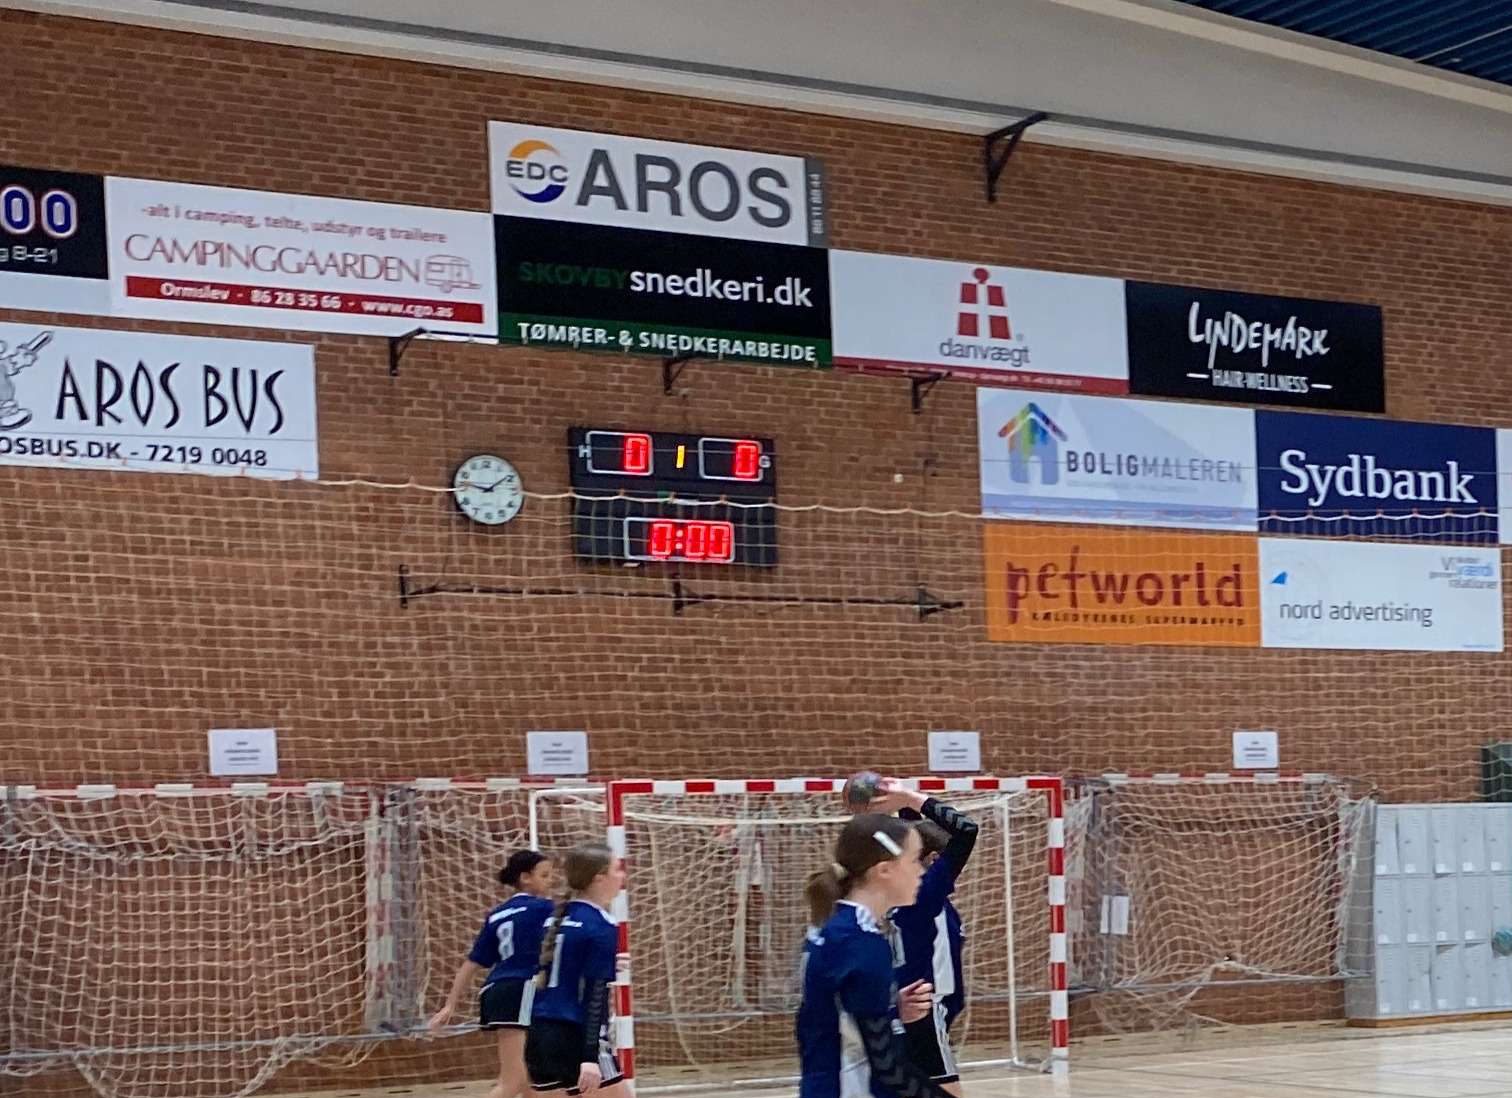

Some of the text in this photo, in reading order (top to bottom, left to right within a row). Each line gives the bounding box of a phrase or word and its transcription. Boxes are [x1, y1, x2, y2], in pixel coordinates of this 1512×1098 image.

[505, 160, 569, 183] EDC
[575, 148, 791, 229] AROS
[124, 233, 422, 284] CAMPINGGAARDEN
[639, 332, 816, 362] SNEDKERARBEJDE
[938, 336, 1031, 368] danvægt
[1188, 301, 1331, 369] LINDEMARK
[55, 355, 286, 436] AROS BUS
[146, 444, 202, 465] 7219
[212, 448, 268, 467] 0048
[1066, 450, 1243, 485] BOLIGMALEREN
[1280, 449, 1478, 507] Sydbank
[1005, 545, 1246, 626] petworld
[1280, 601, 1434, 628] nord advertising
